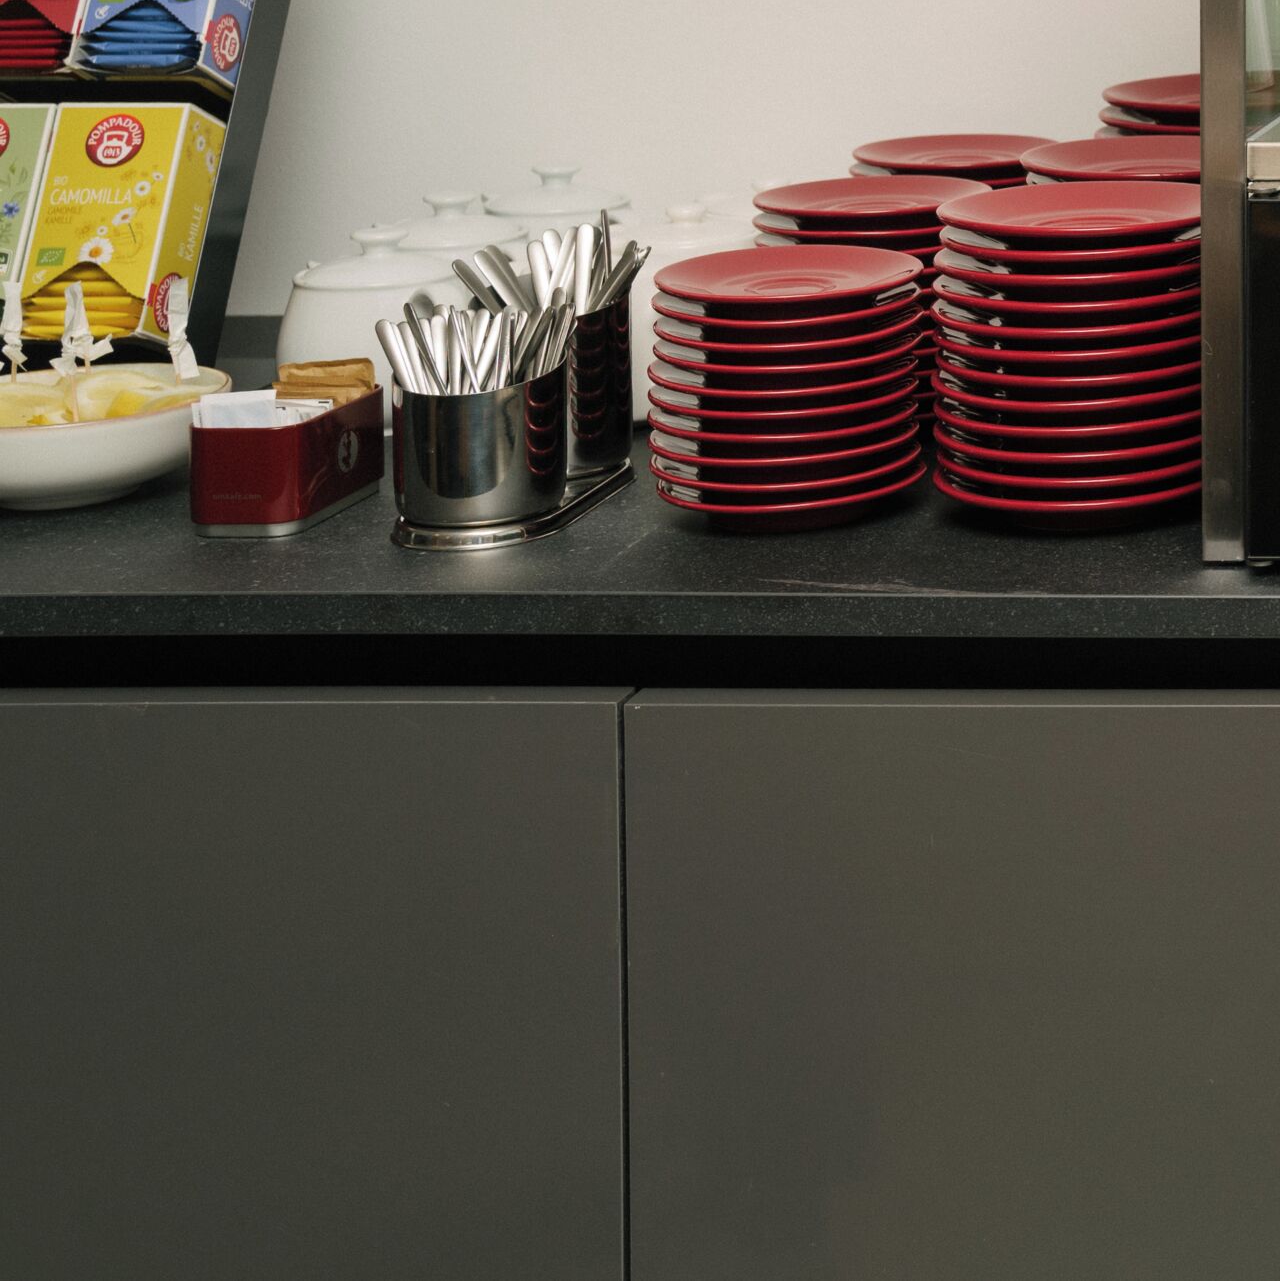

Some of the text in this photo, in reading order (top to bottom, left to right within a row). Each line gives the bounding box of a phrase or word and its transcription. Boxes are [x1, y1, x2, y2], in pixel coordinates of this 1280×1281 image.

[88, 117, 142, 146] POMPADOUR
[50, 189, 133, 205] CAMOMILLA
[184, 205, 204, 262] KAMILLE
